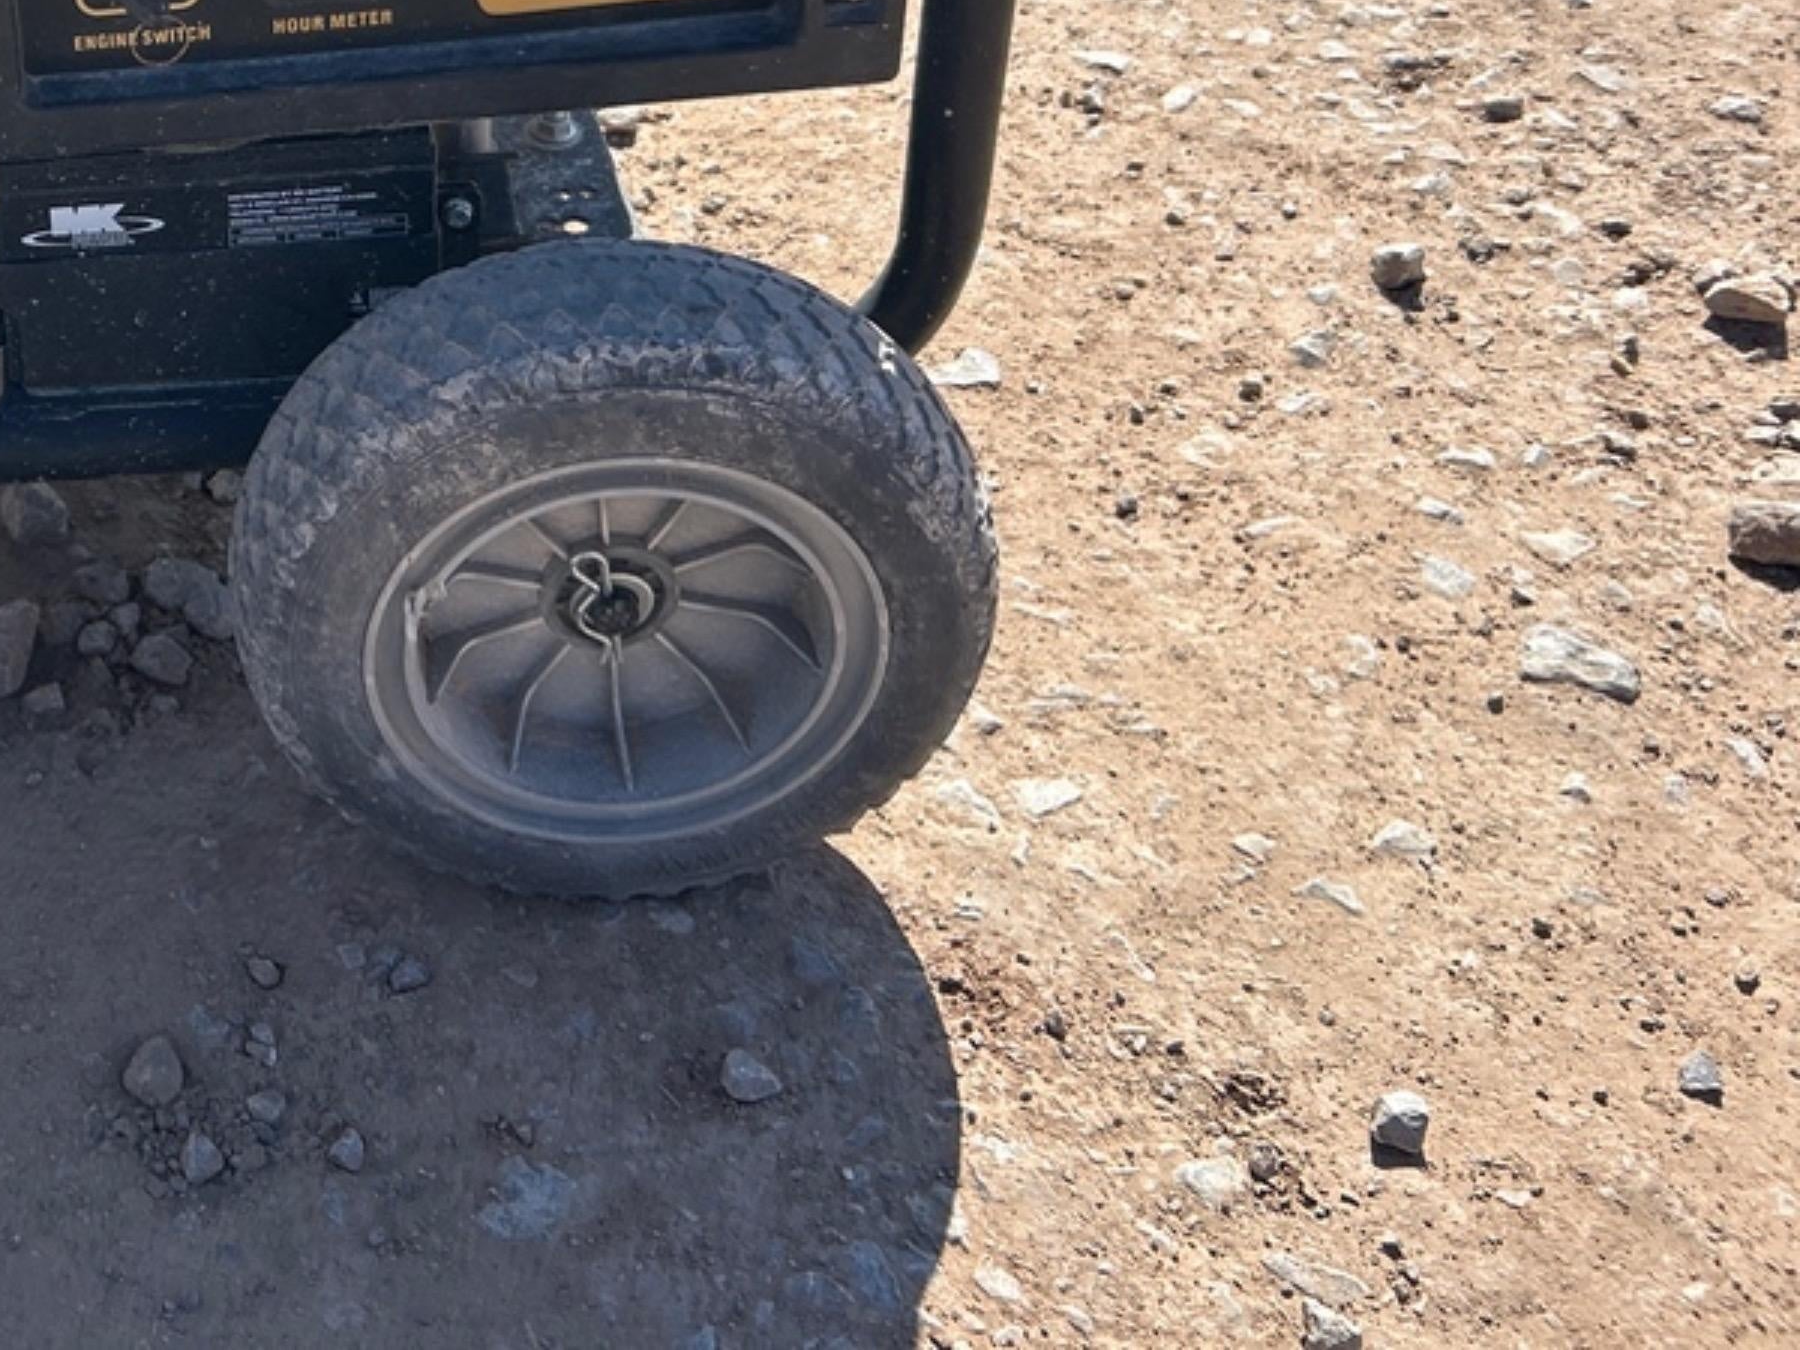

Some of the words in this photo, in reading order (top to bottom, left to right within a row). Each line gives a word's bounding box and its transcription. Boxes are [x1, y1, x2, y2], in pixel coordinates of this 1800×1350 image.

[272, 14, 326, 35] HOUR
[330, 8, 394, 29] METER
[73, 31, 137, 52] ENGINE
[143, 24, 212, 46] SWITCH
